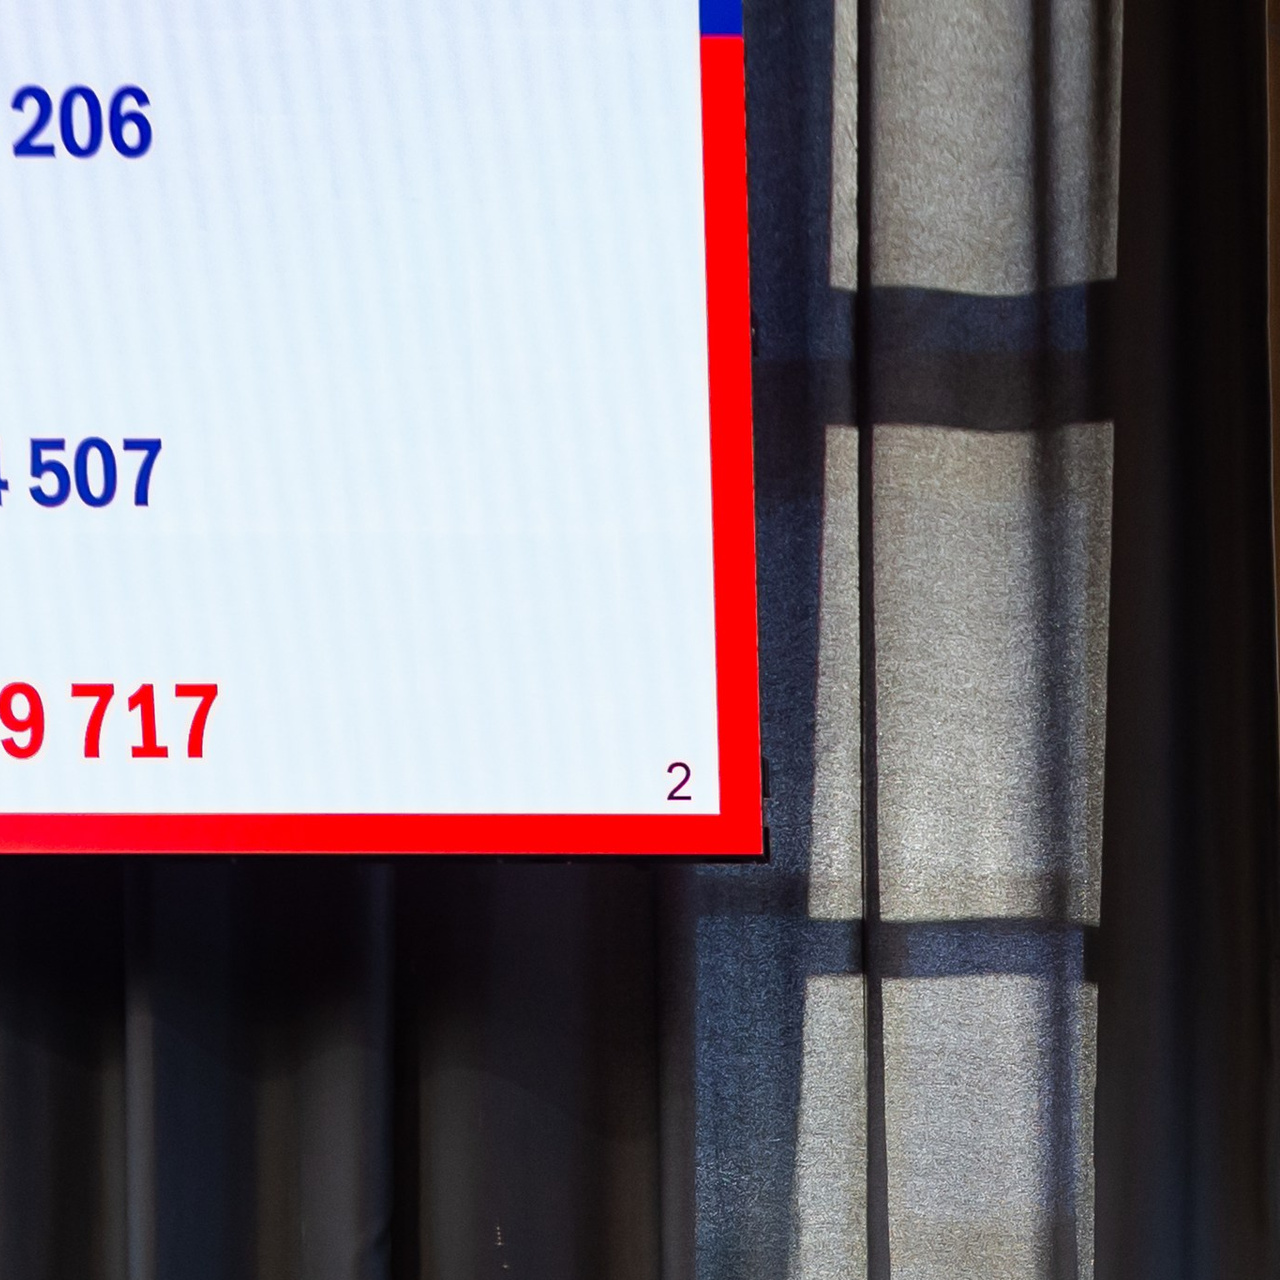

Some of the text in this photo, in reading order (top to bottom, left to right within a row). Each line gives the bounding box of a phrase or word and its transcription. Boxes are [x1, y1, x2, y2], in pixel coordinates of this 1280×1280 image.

[11, 85, 153, 159] 206
[29, 436, 163, 508] 507
[0, 682, 218, 760] 9 717
[665, 761, 692, 801] 2
